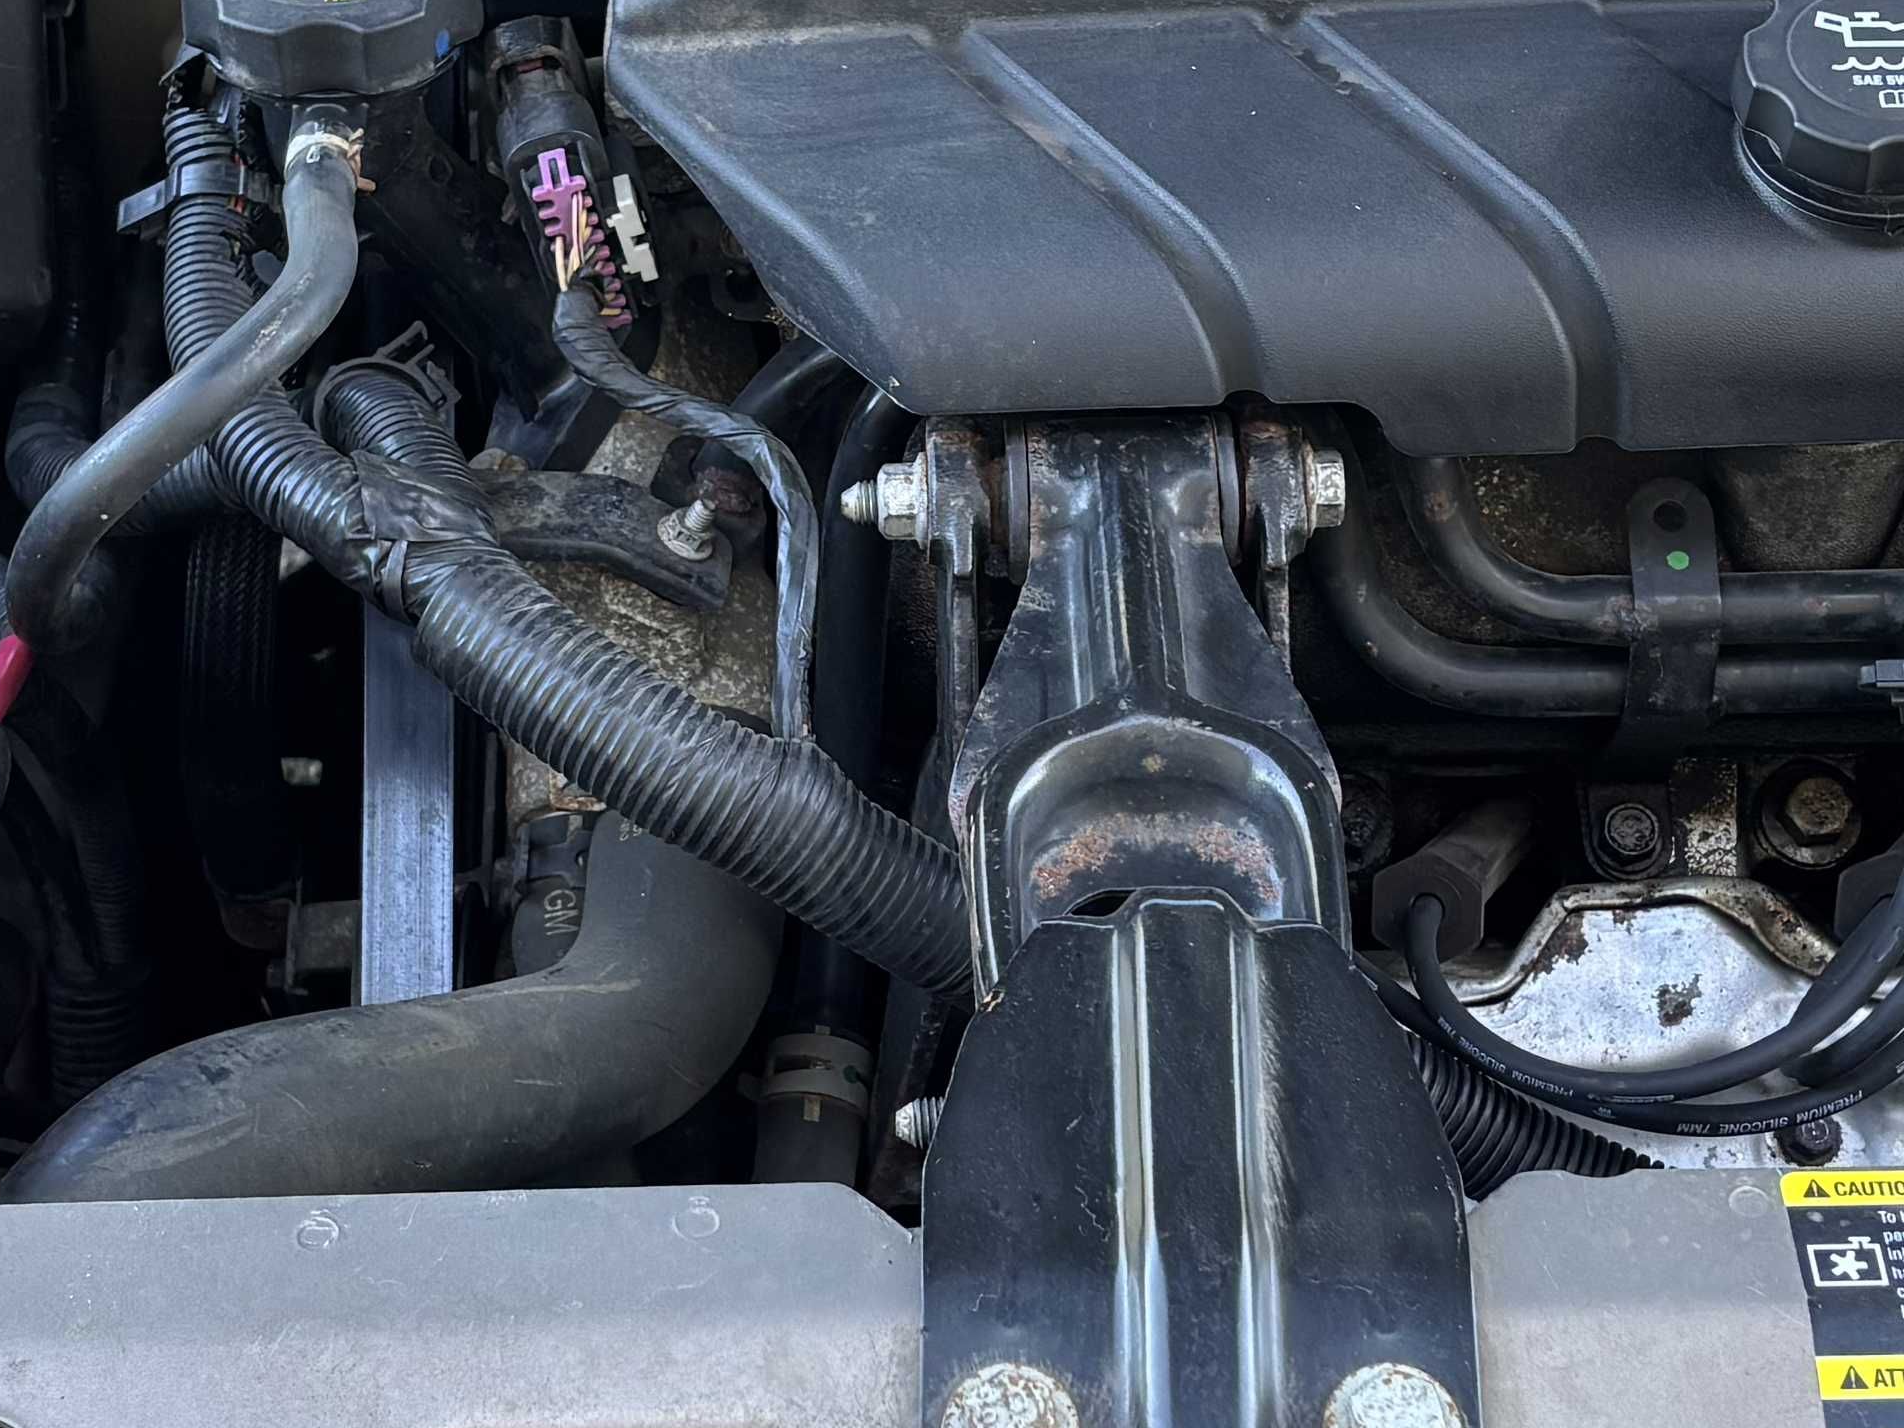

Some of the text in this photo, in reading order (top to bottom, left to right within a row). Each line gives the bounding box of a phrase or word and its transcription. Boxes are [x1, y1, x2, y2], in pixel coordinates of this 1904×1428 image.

[1852, 75, 1884, 86] SAE
[1677, 1090, 1863, 1136] PREMIUM SILICONE 7MM
